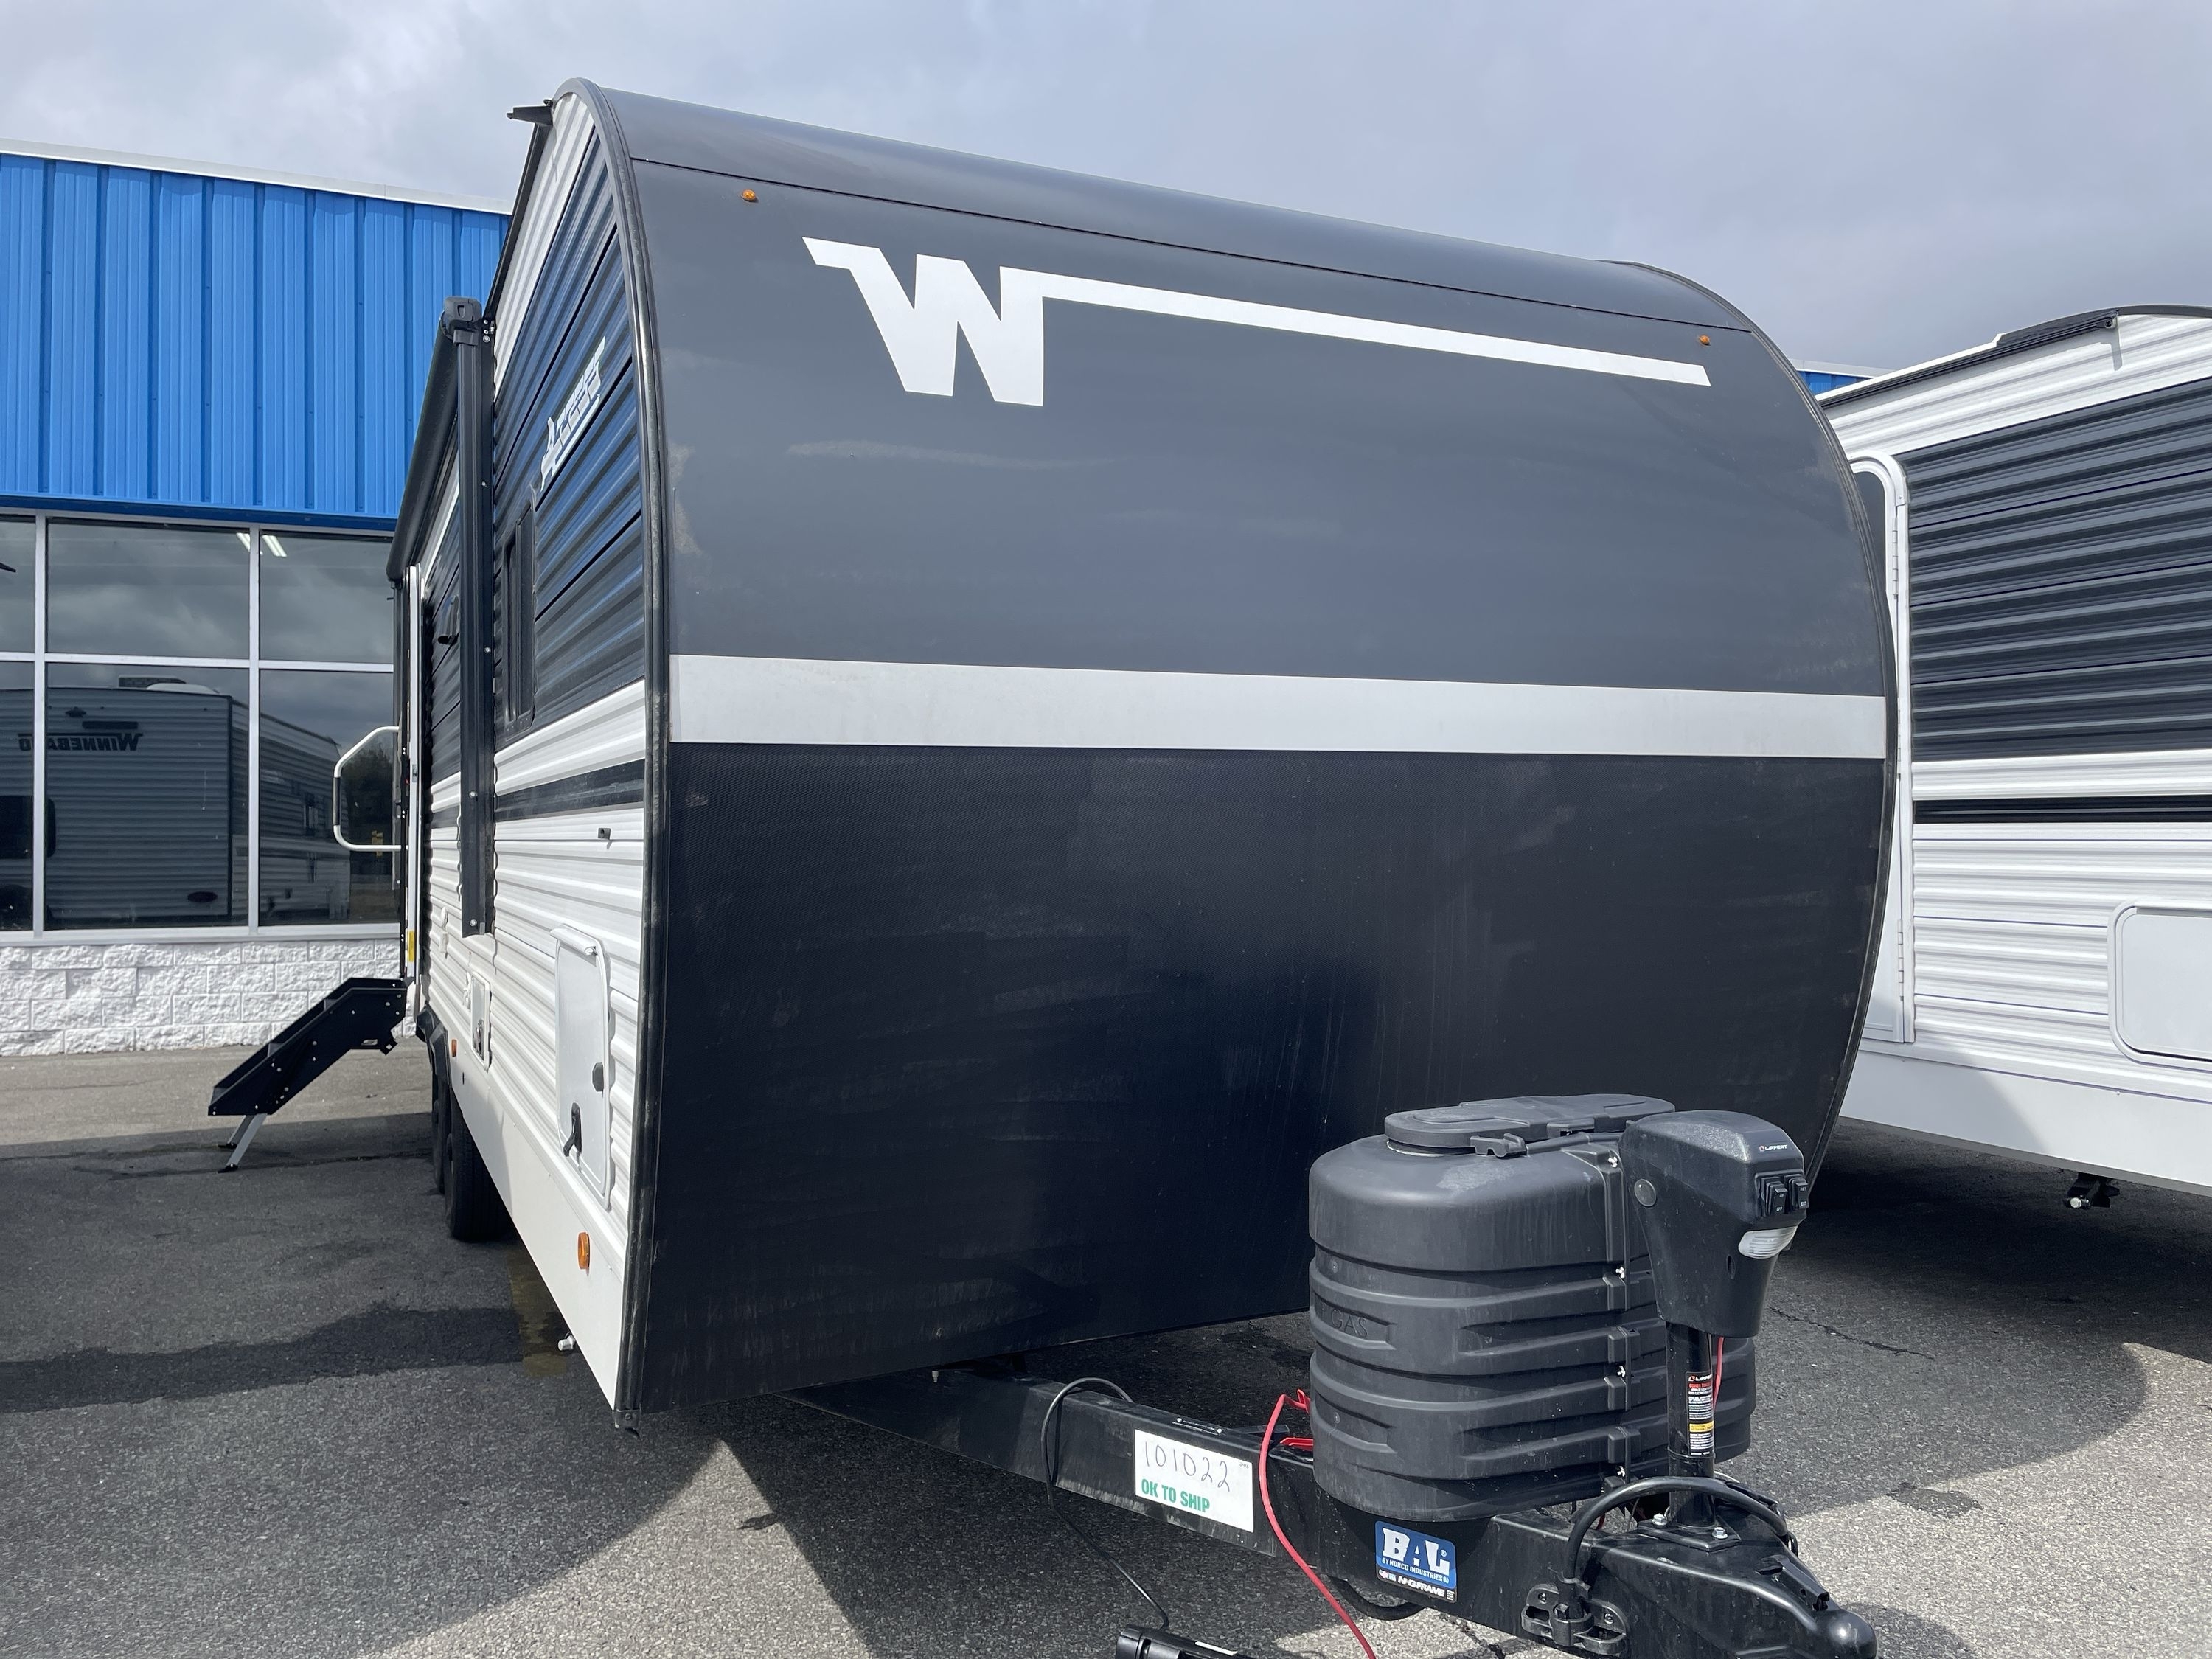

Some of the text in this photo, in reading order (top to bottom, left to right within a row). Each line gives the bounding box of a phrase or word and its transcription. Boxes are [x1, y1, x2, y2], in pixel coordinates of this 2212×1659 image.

[1332, 1308, 1368, 1339] GAS
[1145, 1441, 1230, 1492] 101022
[1141, 1478, 1211, 1512] OK TO SHIP
[1382, 1528, 1450, 1576] BAL
[1410, 1566, 1443, 1582] INDUSTRIES
[1416, 1581, 1445, 1597] FRAME
